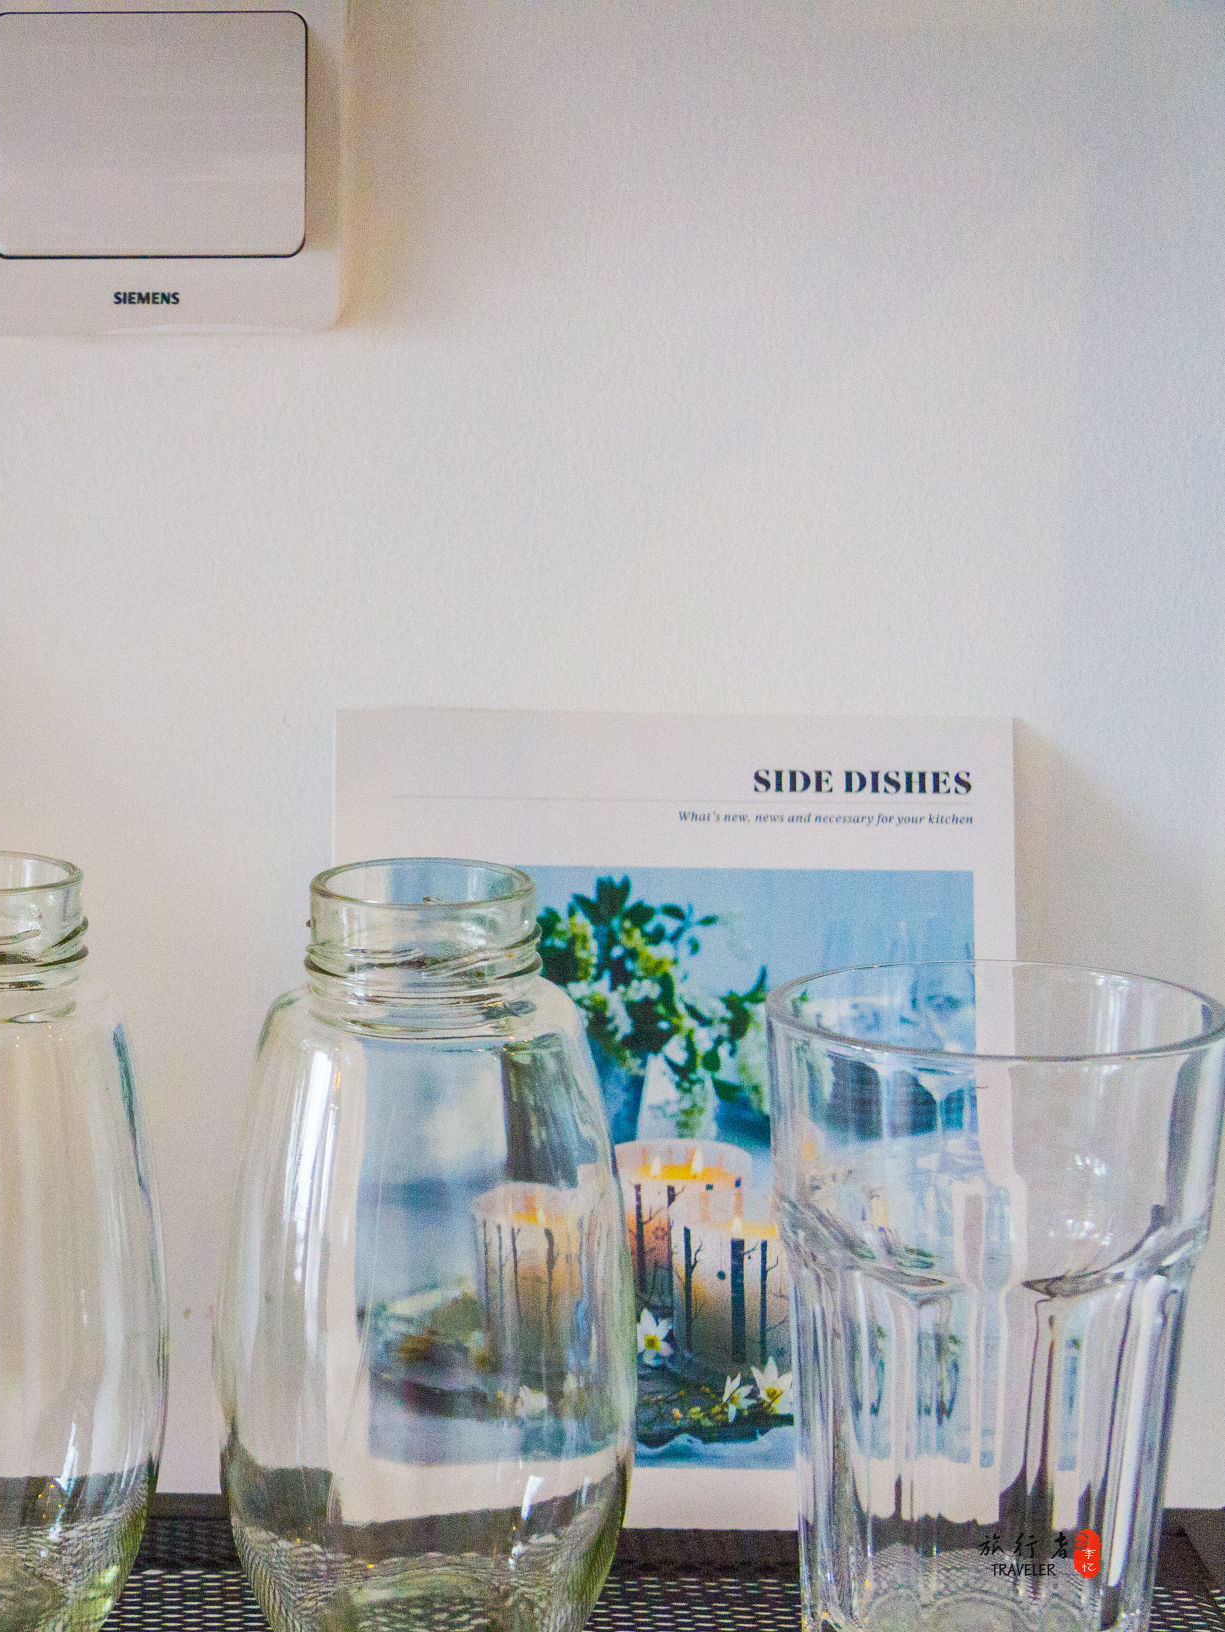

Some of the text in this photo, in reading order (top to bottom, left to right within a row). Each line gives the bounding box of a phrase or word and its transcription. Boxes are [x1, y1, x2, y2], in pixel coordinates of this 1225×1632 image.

[113, 291, 180, 305] SIEMENS
[753, 768, 973, 796] SIDE DISHES
[678, 811, 973, 827] What's new, news and necessary for your kitchen
